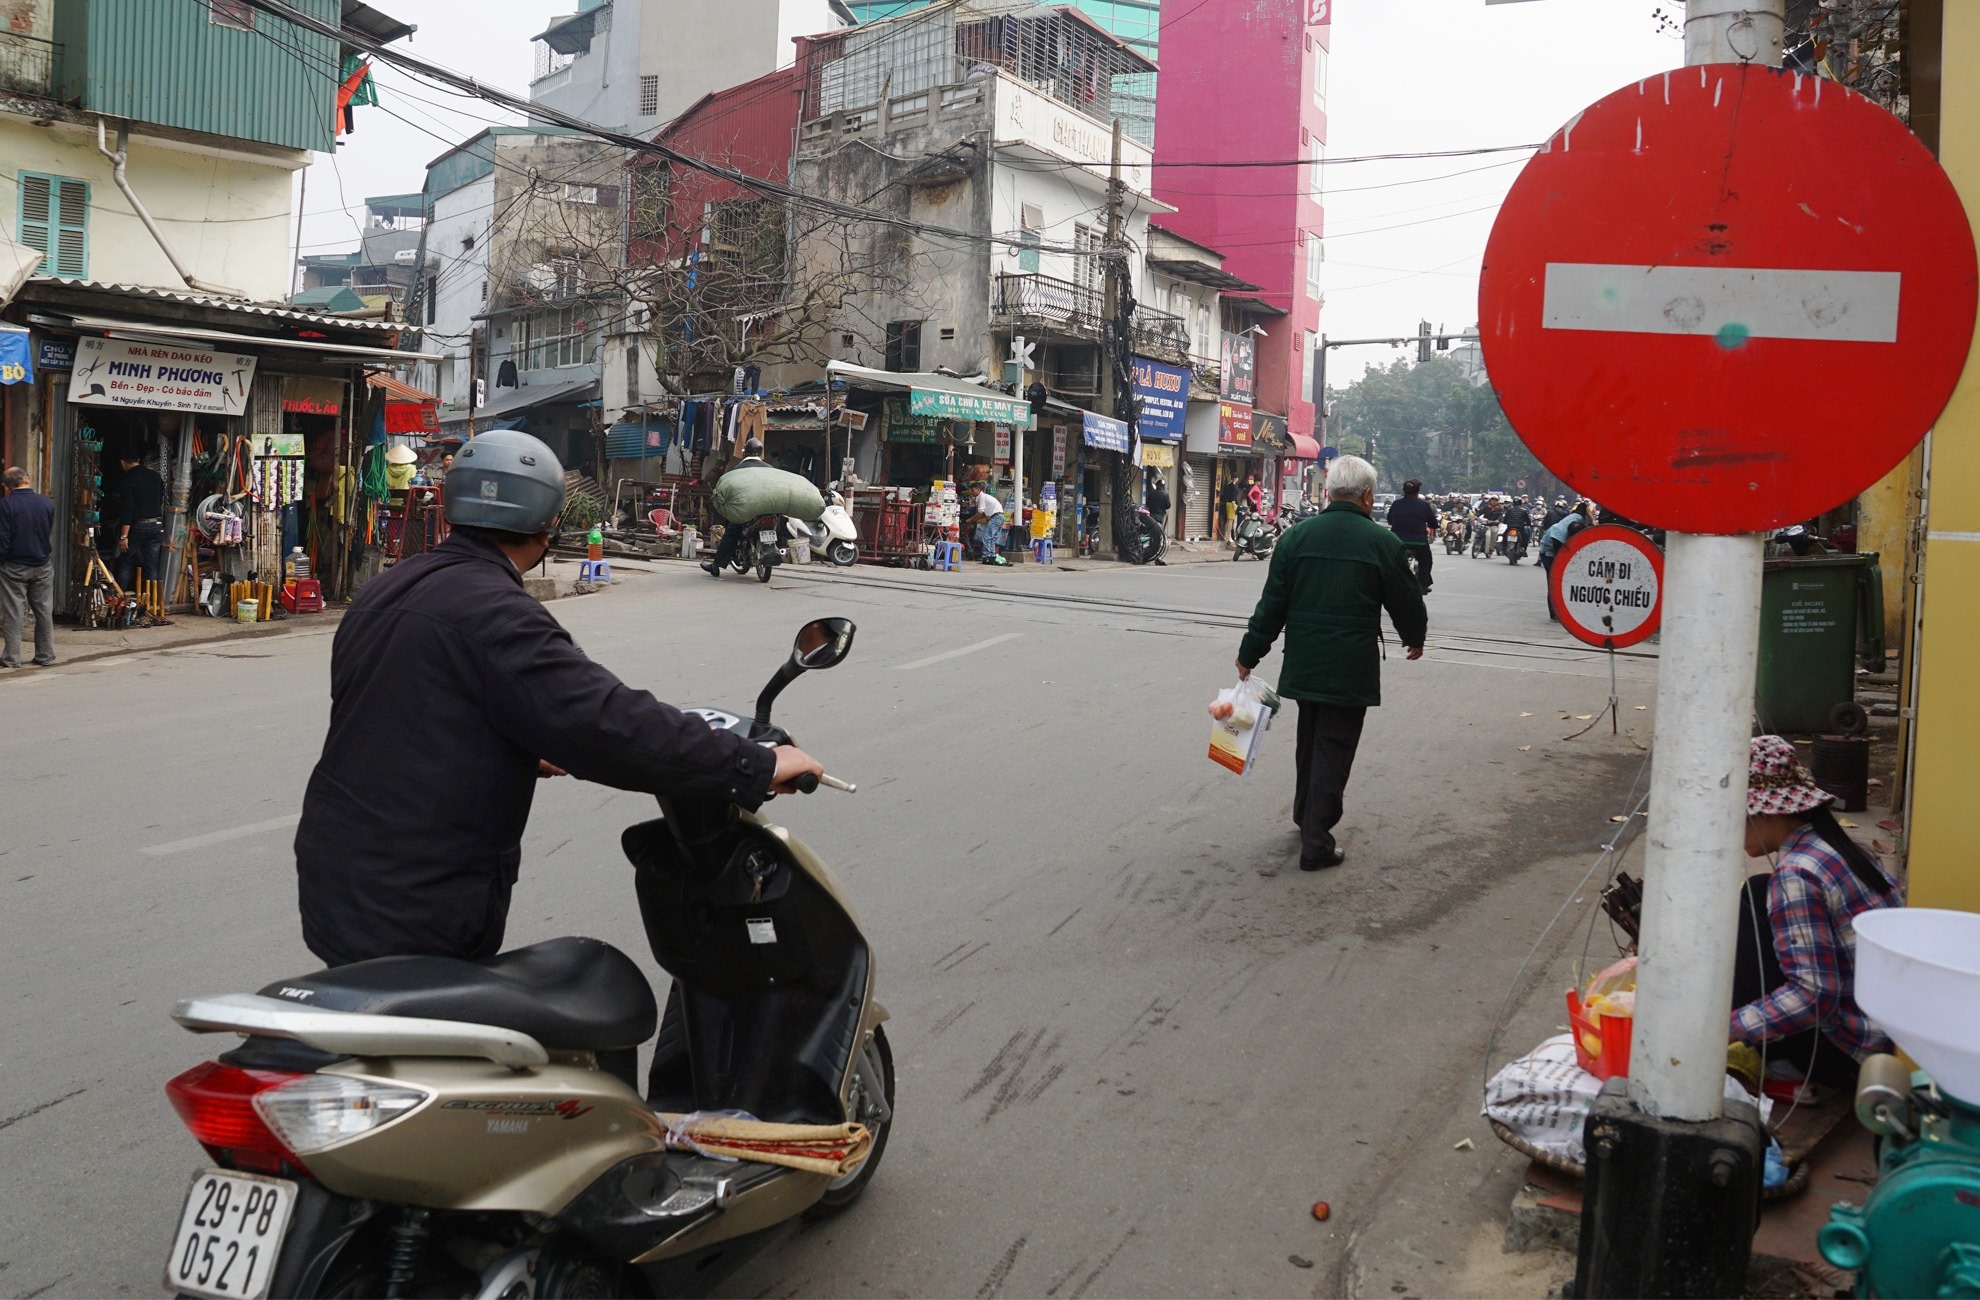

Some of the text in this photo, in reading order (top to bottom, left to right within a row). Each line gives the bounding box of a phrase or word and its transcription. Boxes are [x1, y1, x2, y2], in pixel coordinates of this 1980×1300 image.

[171, 352, 192, 362] DAO
[1, 361, 26, 380] BÒ
[108, 361, 224, 385] MINH PHƯƠNG
[136, 383, 155, 394] Đẹp
[162, 385, 174, 394] Có
[1153, 370, 1182, 392] HUXU
[283, 397, 339, 415] THUỐC LÀO
[982, 400, 993, 410] XE
[1588, 556, 1632, 580] CẤM ĐI
[1569, 585, 1611, 608] NGƯỢC
[486, 1119, 529, 1134] YAMAHA
[194, 1178, 278, 1237] 29-P8
[180, 1232, 260, 1296] 0521
